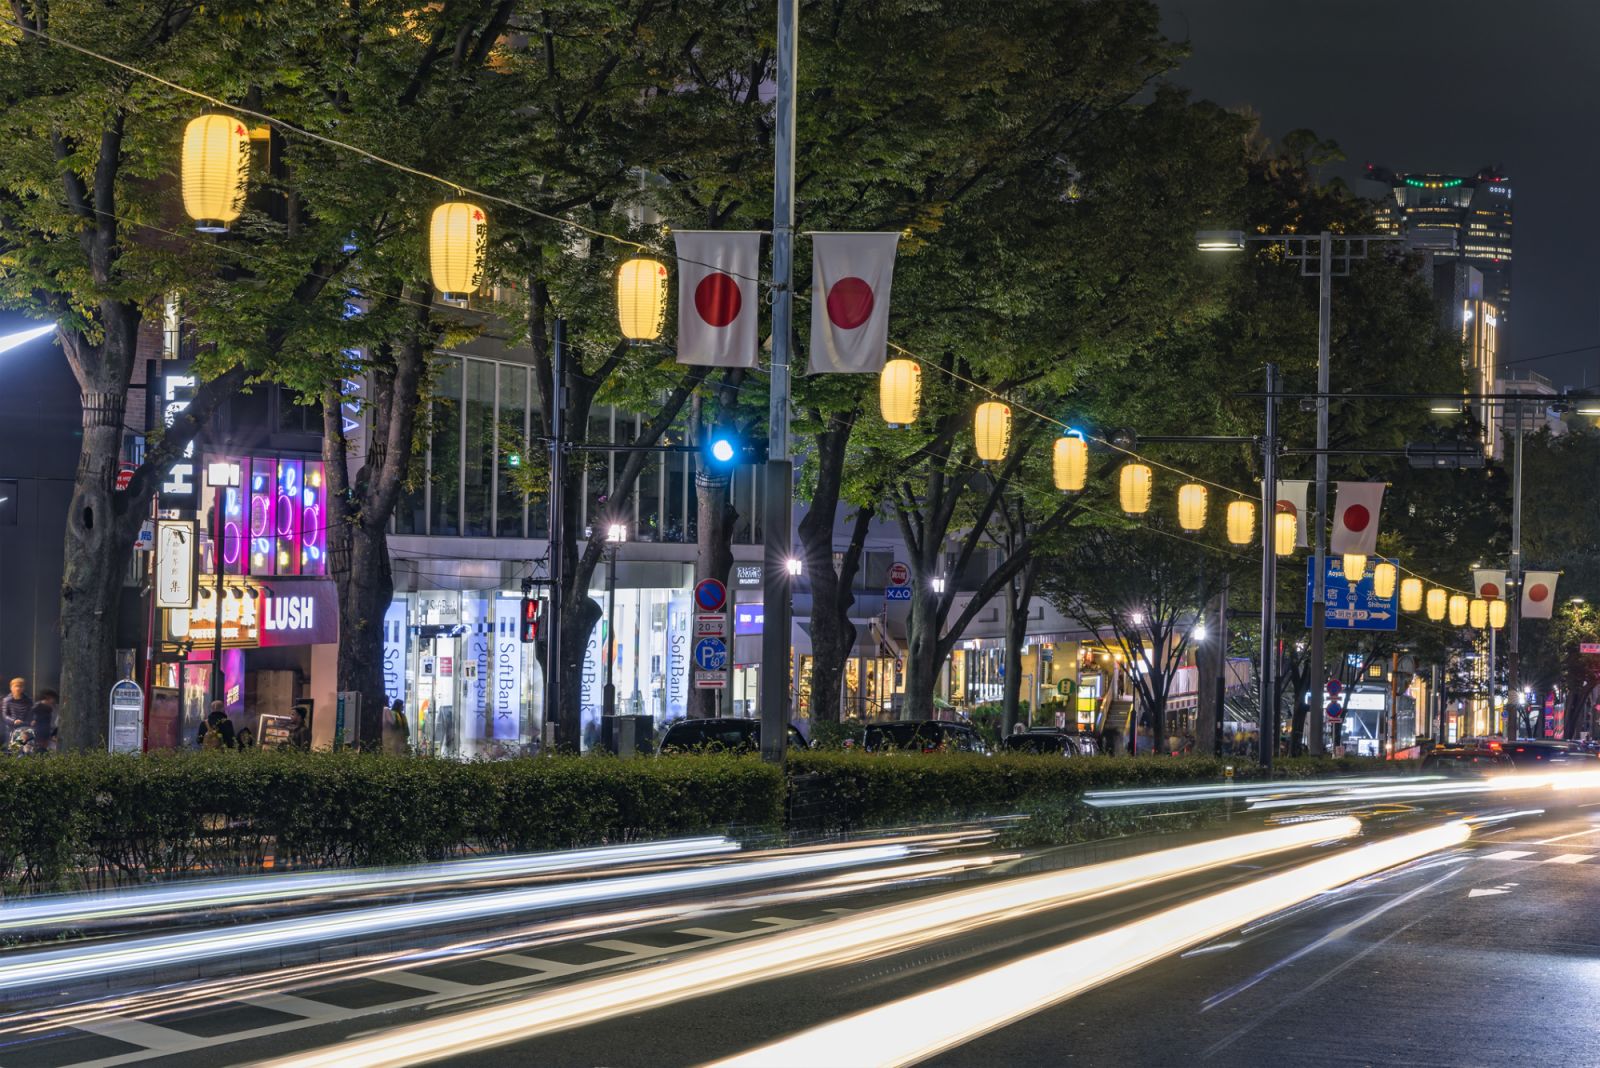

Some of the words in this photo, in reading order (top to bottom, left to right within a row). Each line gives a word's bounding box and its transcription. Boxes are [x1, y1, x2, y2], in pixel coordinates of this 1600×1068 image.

[163, 376, 195, 494] LUH
[265, 596, 313, 630] LUSH
[384, 646, 399, 708] SoftB
[499, 643, 515, 720] SoftBank
[671, 635, 686, 704] SoftBank
[702, 646, 714, 667] P
